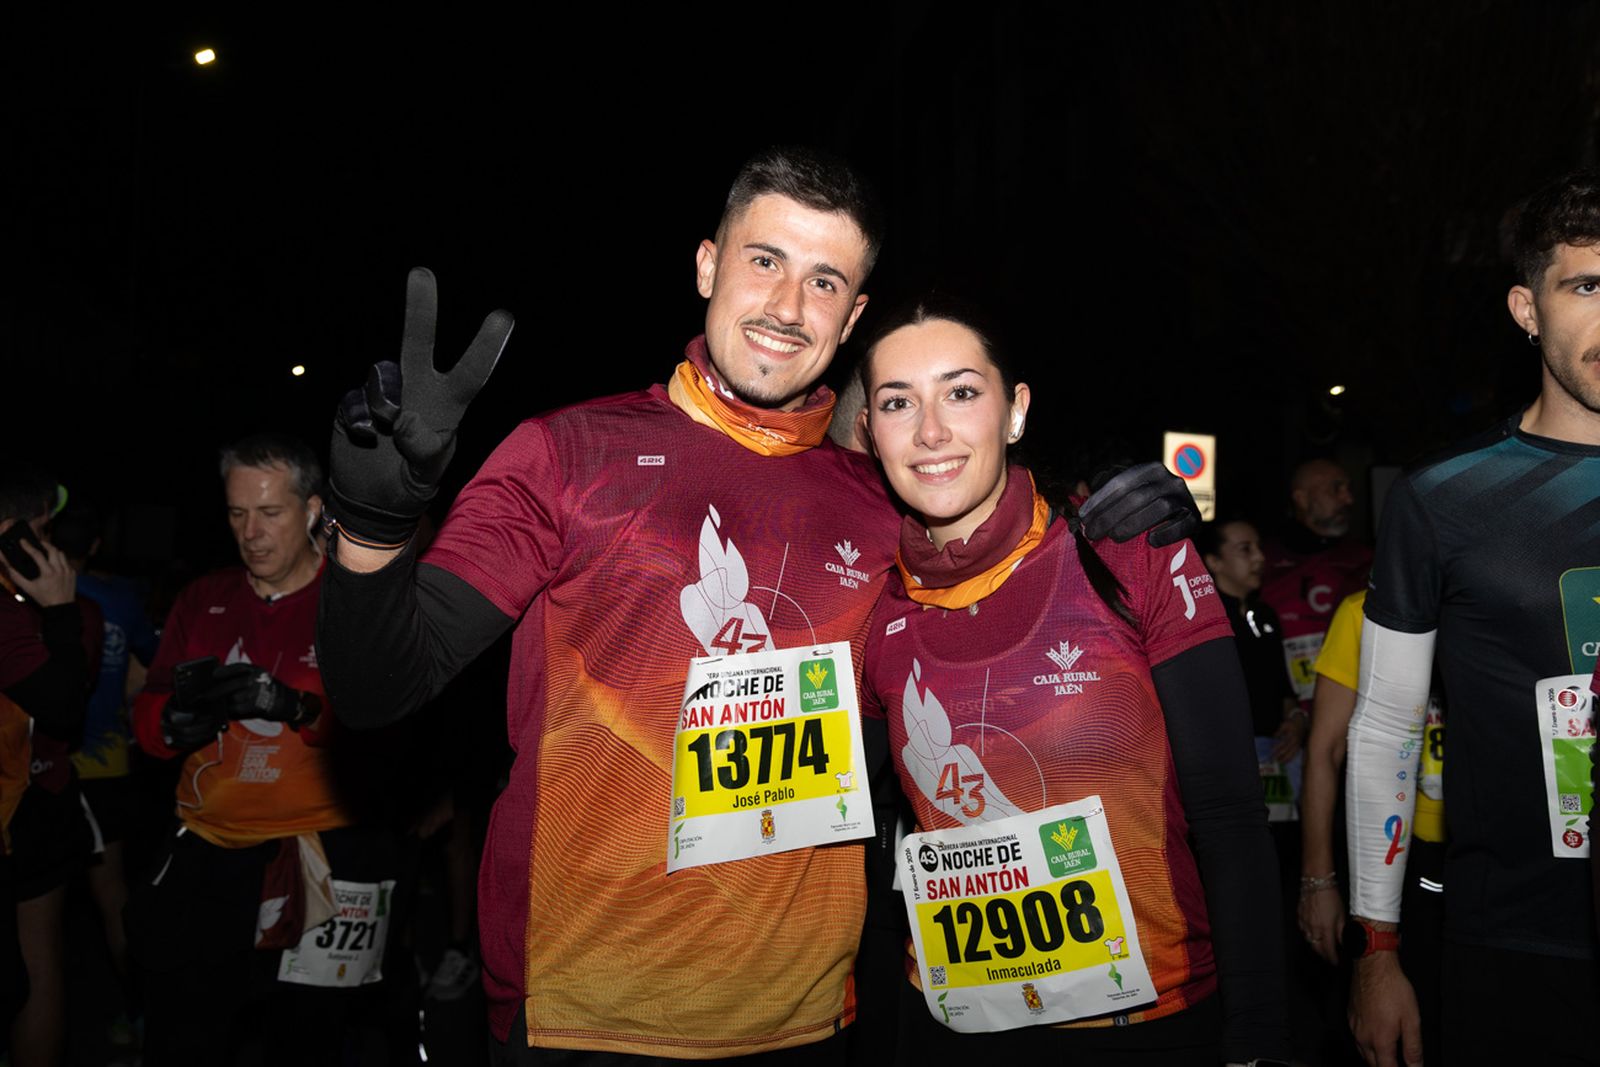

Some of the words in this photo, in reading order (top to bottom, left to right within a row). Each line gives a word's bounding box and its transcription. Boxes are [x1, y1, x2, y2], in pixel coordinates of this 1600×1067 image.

[846, 567, 870, 583] RURAL
[763, 674, 784, 693] DE
[1033, 673, 1061, 686] CAJA
[1062, 671, 1101, 683] RURAL
[1054, 683, 1083, 696] JAÉN
[682, 708, 713, 731] SAN
[719, 694, 785, 725] ANTÓN
[688, 718, 830, 793] 13774
[732, 791, 761, 809] José
[764, 787, 795, 804] Pablo
[935, 762, 986, 818] 43
[977, 833, 1018, 847] INTERNACIONAL
[919, 852, 936, 866] 43
[941, 846, 997, 871] NOCHE
[998, 842, 1023, 864] DE
[926, 877, 962, 900] SAN
[965, 864, 1030, 896] ANTÓN
[933, 879, 1105, 964] 12908
[316, 920, 377, 950] 3721
[986, 957, 1062, 981] Inmaculada
